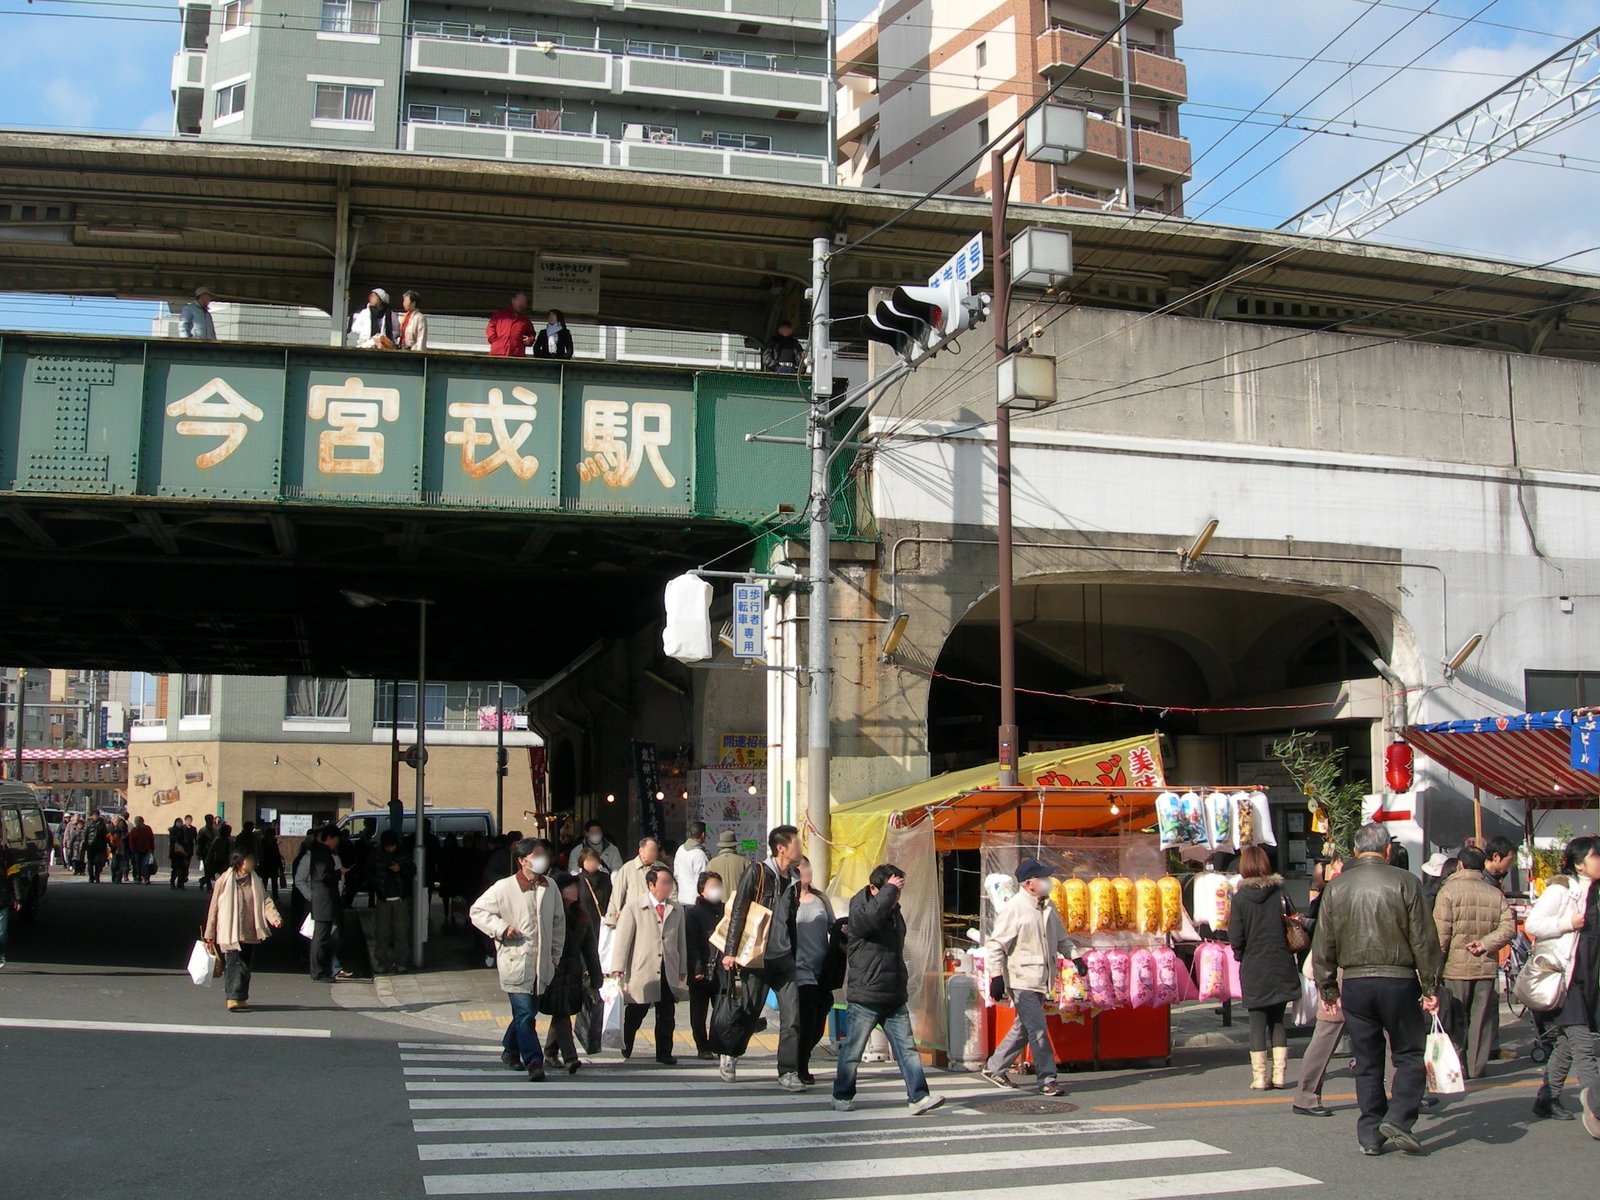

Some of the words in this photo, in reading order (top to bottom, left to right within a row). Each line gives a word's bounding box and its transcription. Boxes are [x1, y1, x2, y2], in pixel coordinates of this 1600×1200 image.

[166, 377, 676, 488] 今宮戎駅
[738, 589, 748, 625] 自転車
[750, 589, 760, 625] 歩行者
[744, 628, 754, 652] 専用
